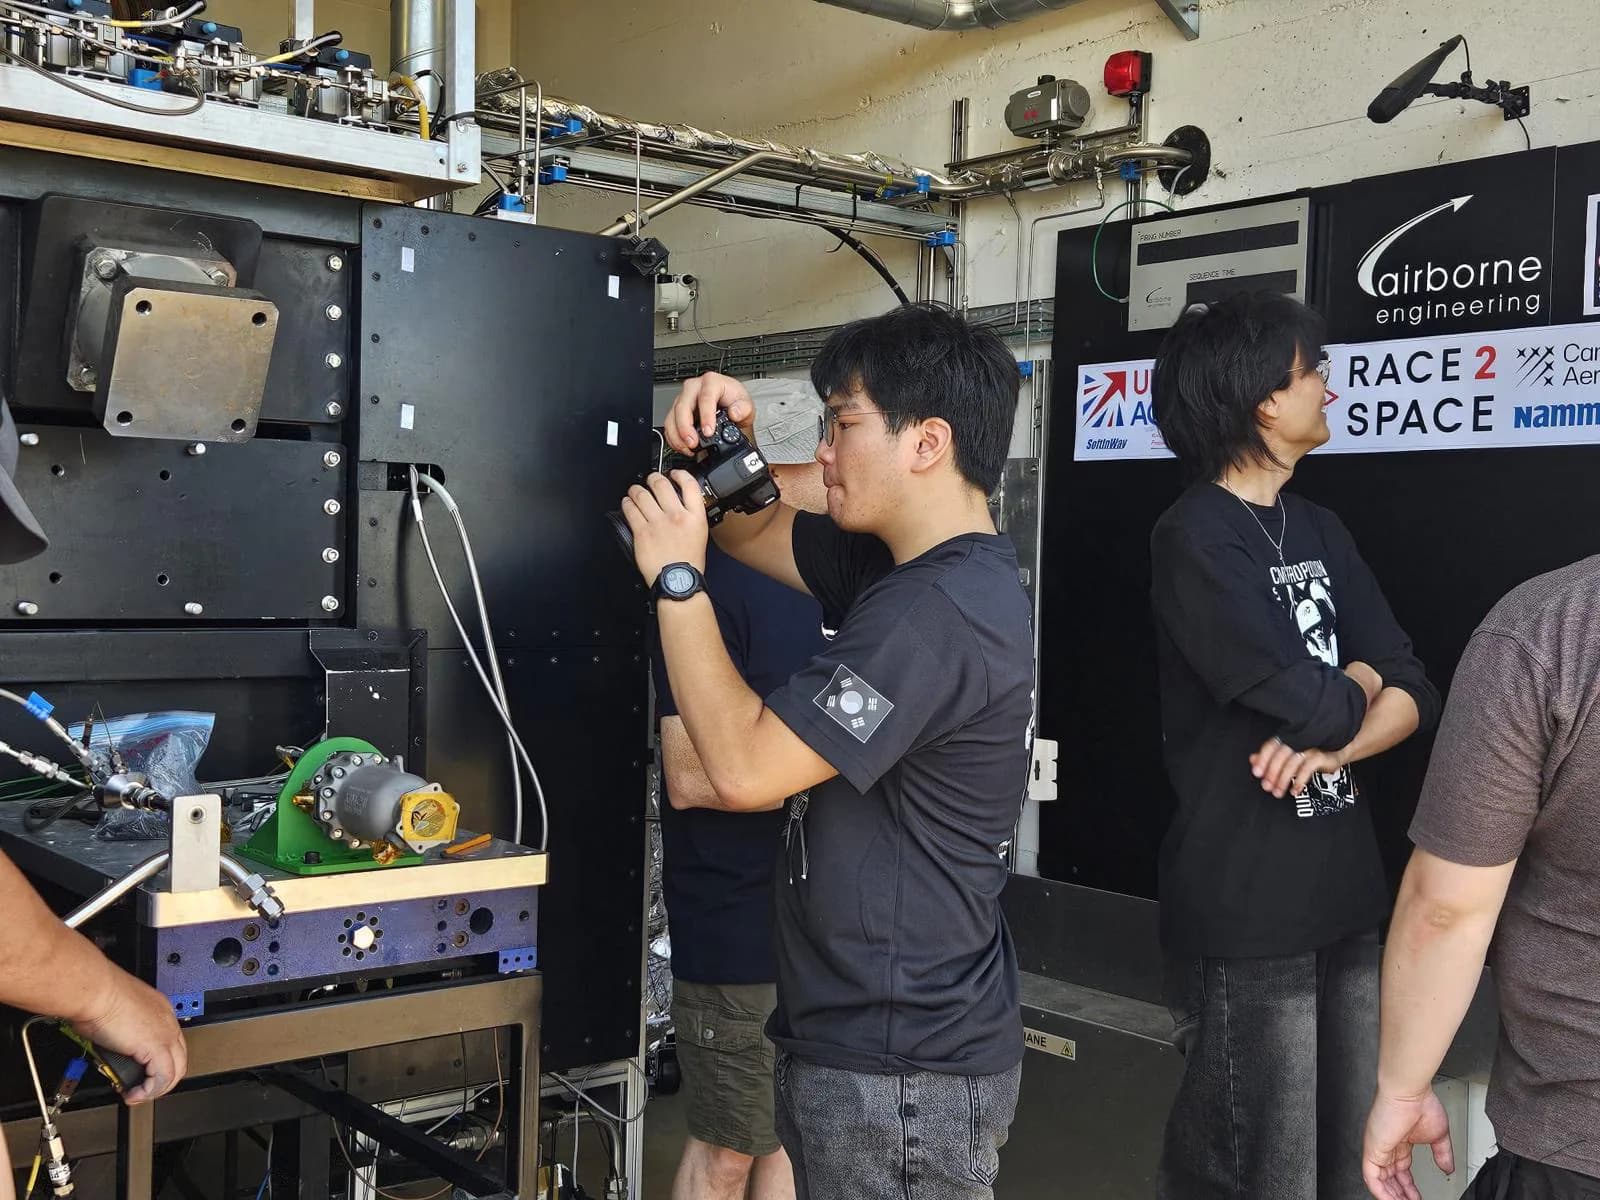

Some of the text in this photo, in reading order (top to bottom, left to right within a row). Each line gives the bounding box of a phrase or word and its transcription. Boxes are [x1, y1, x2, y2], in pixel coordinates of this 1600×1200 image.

[1158, 229, 1182, 239] NUMBER
[1189, 268, 1236, 281] SEQUENCE TIME
[1378, 256, 1542, 297] airborne
[1376, 294, 1540, 325] engineering
[1348, 345, 1497, 388] RACE 2
[1347, 394, 1495, 437] SPACE
[1024, 1031, 1047, 1048] ANE
